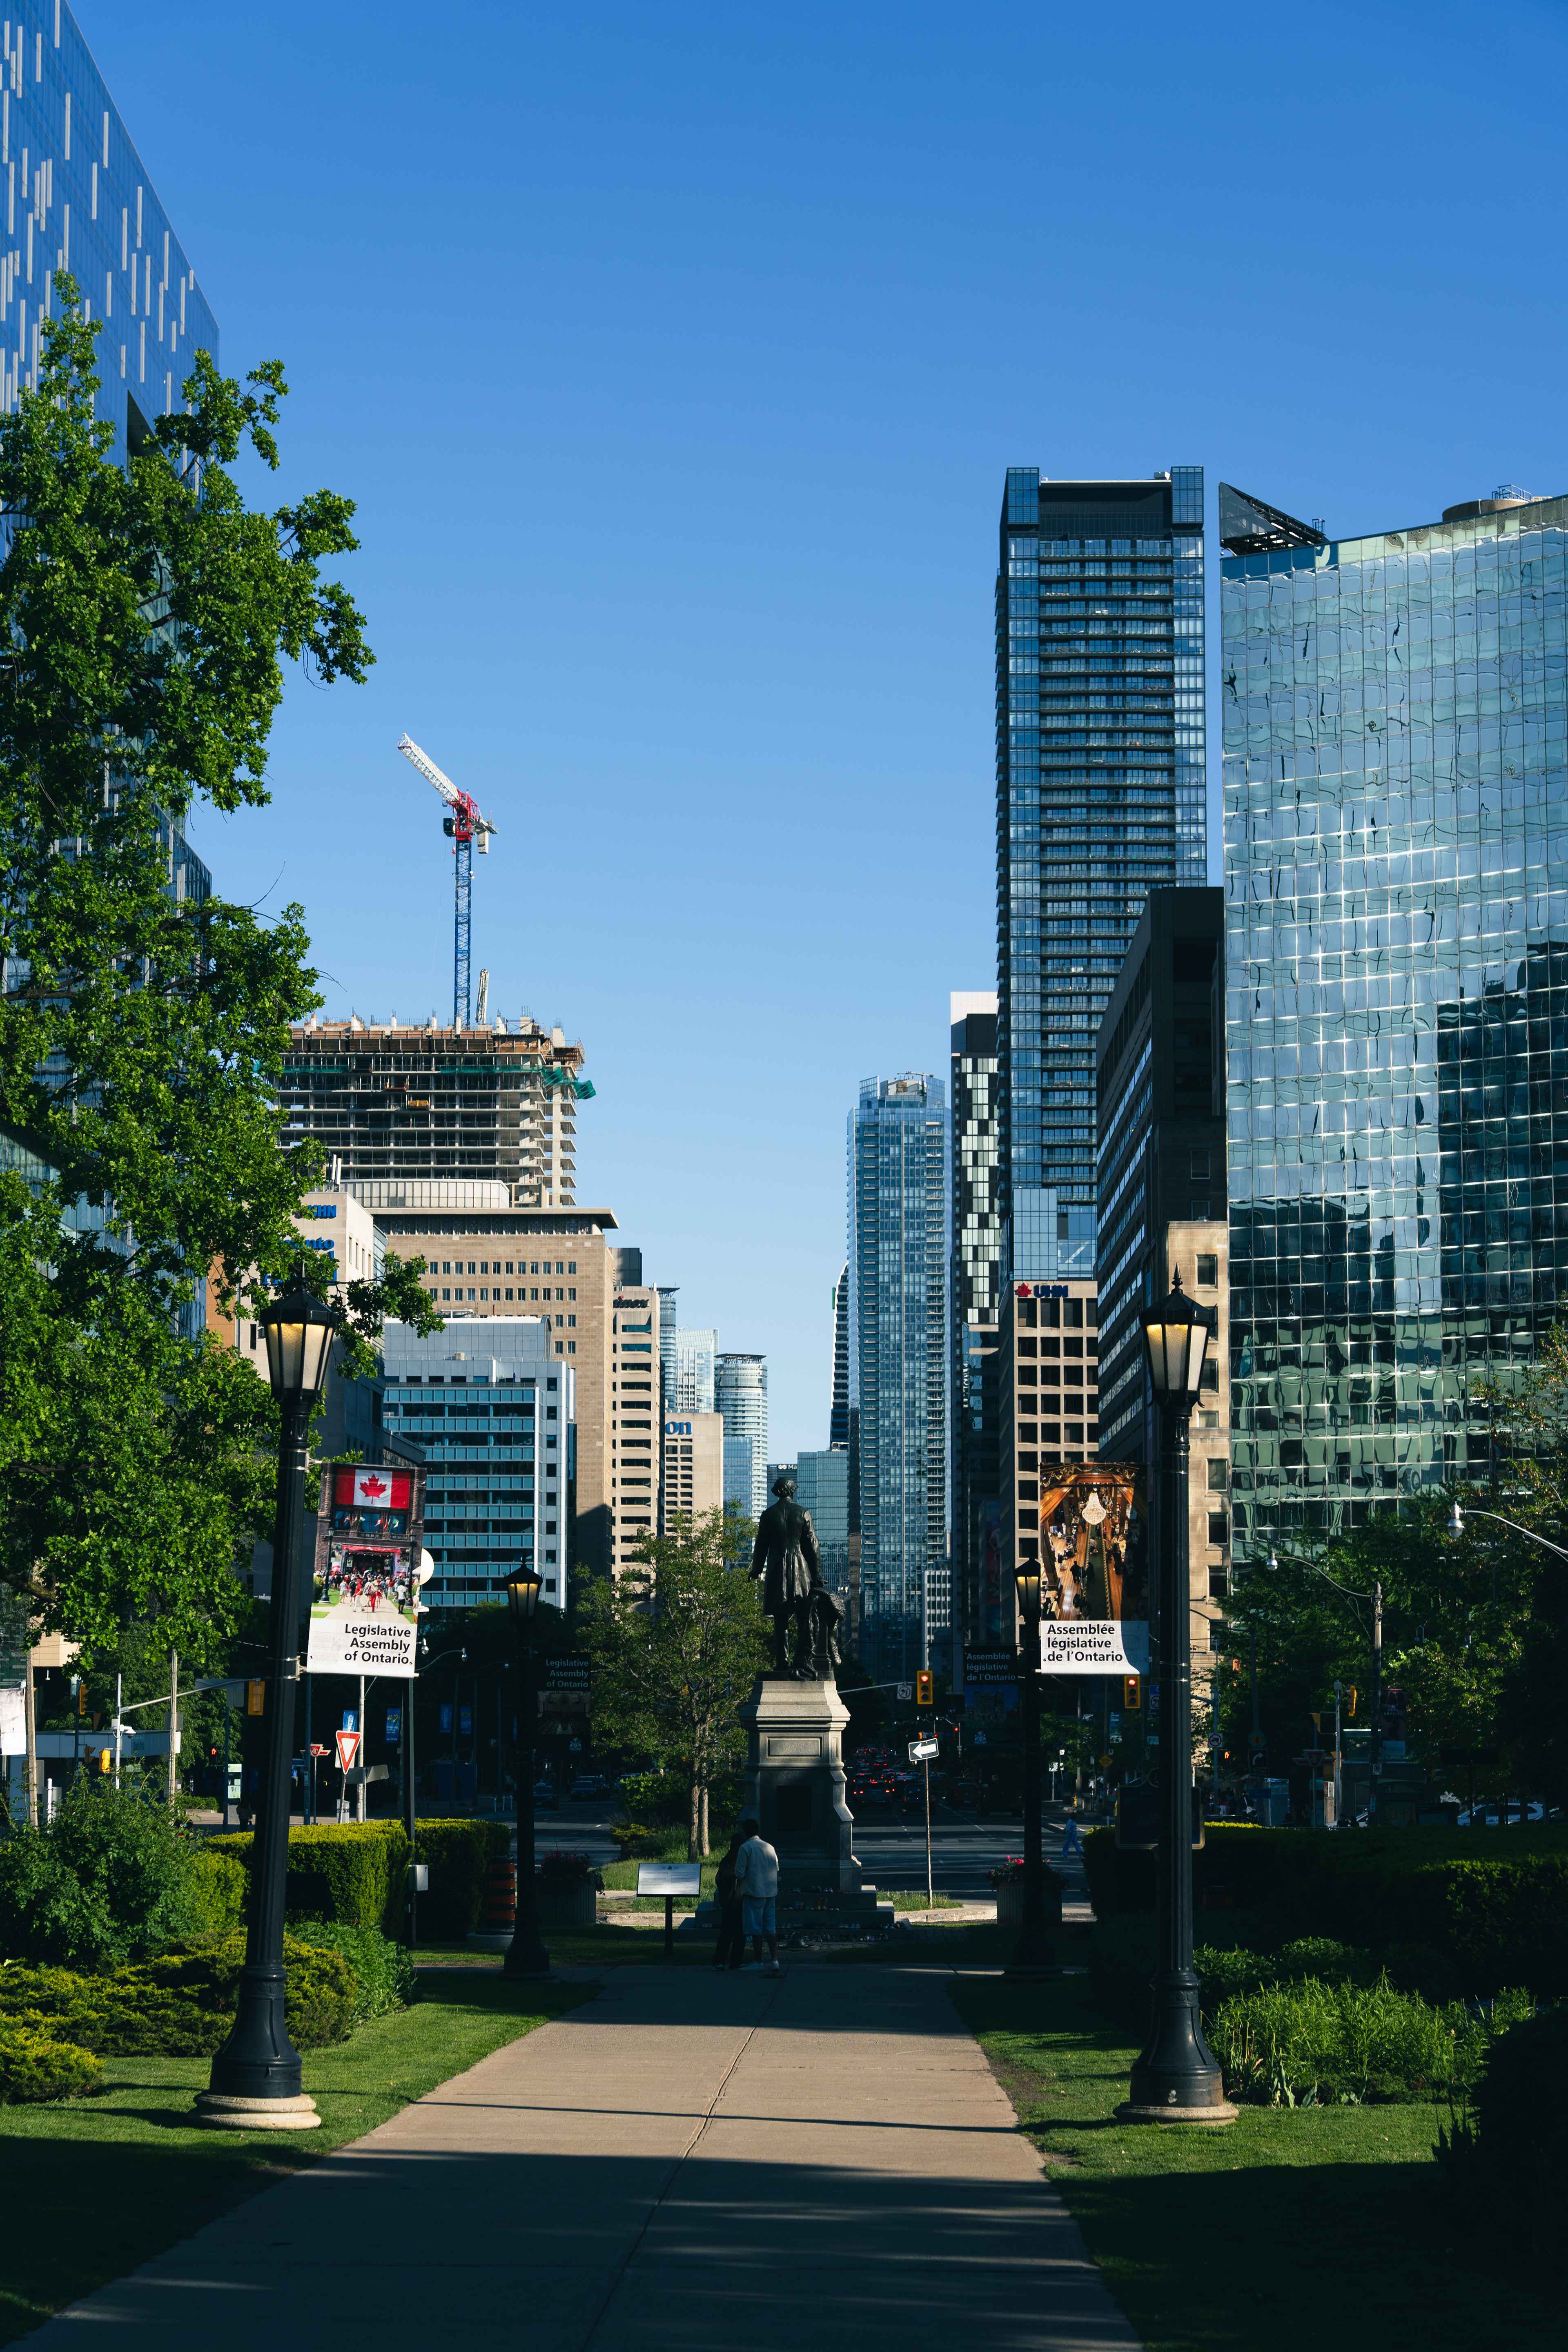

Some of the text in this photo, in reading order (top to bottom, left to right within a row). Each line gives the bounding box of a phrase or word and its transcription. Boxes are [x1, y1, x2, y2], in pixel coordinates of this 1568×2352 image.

[1033, 1285, 1068, 1298] UHN
[345, 1624, 411, 1637] Legislative
[1047, 1624, 1115, 1634] Assemblée
[350, 1637, 410, 1653] Assembly
[1048, 1637, 1111, 1650] législative
[345, 1651, 409, 1664] of Ontario
[1048, 1651, 1123, 1661] de l’Ontario
[546, 1659, 588, 1668] Legislative
[967, 1663, 1008, 1672] législative
[550, 1670, 588, 1679] Assembly
[387, 1715, 399, 1723] #2
